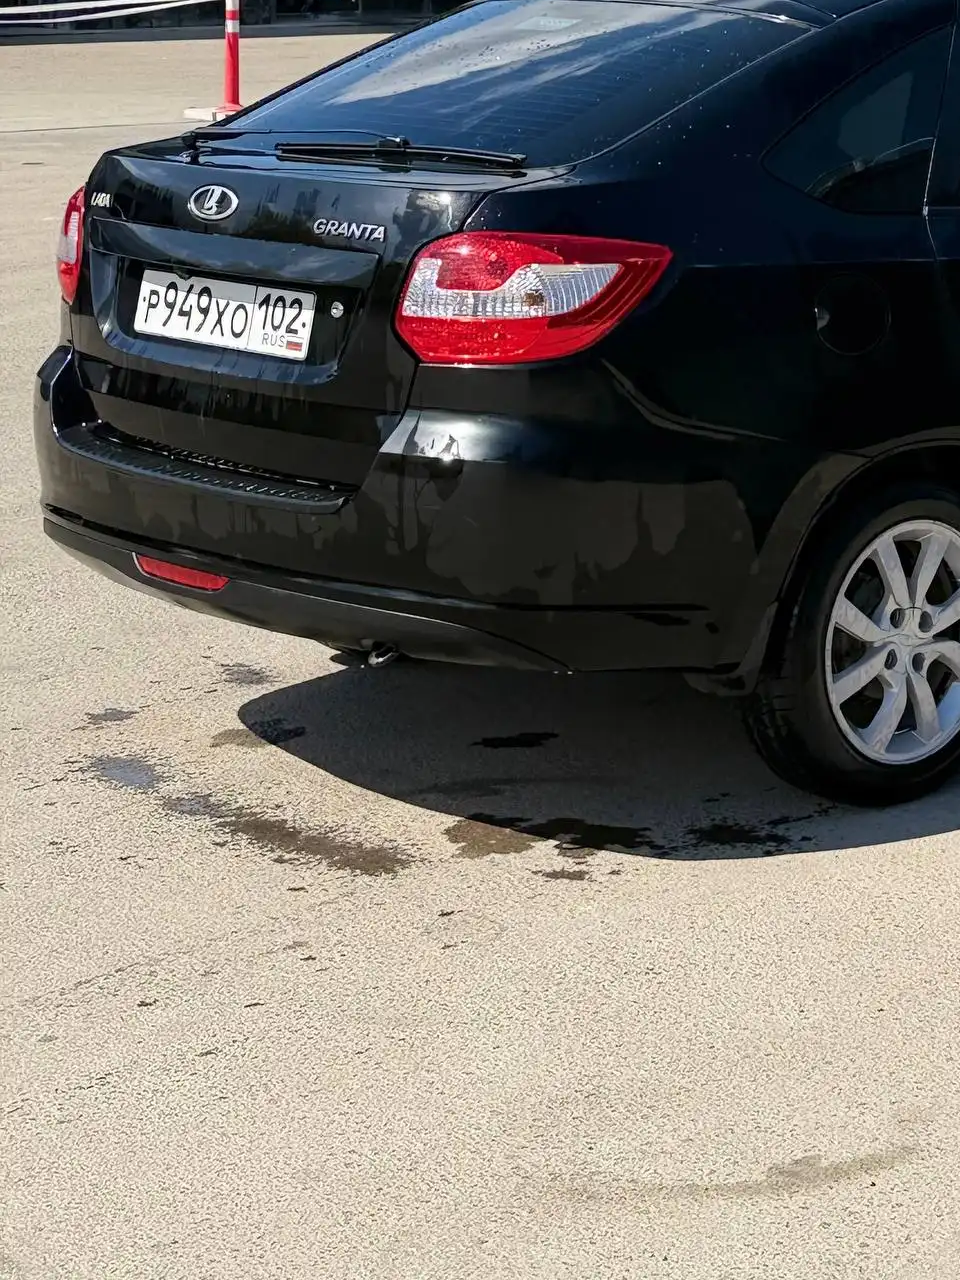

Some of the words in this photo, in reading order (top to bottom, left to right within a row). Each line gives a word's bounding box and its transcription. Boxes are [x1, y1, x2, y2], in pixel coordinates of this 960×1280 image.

[313, 218, 385, 242] GRANTA
[258, 293, 303, 335] 102
[261, 332, 285, 348] RUS
